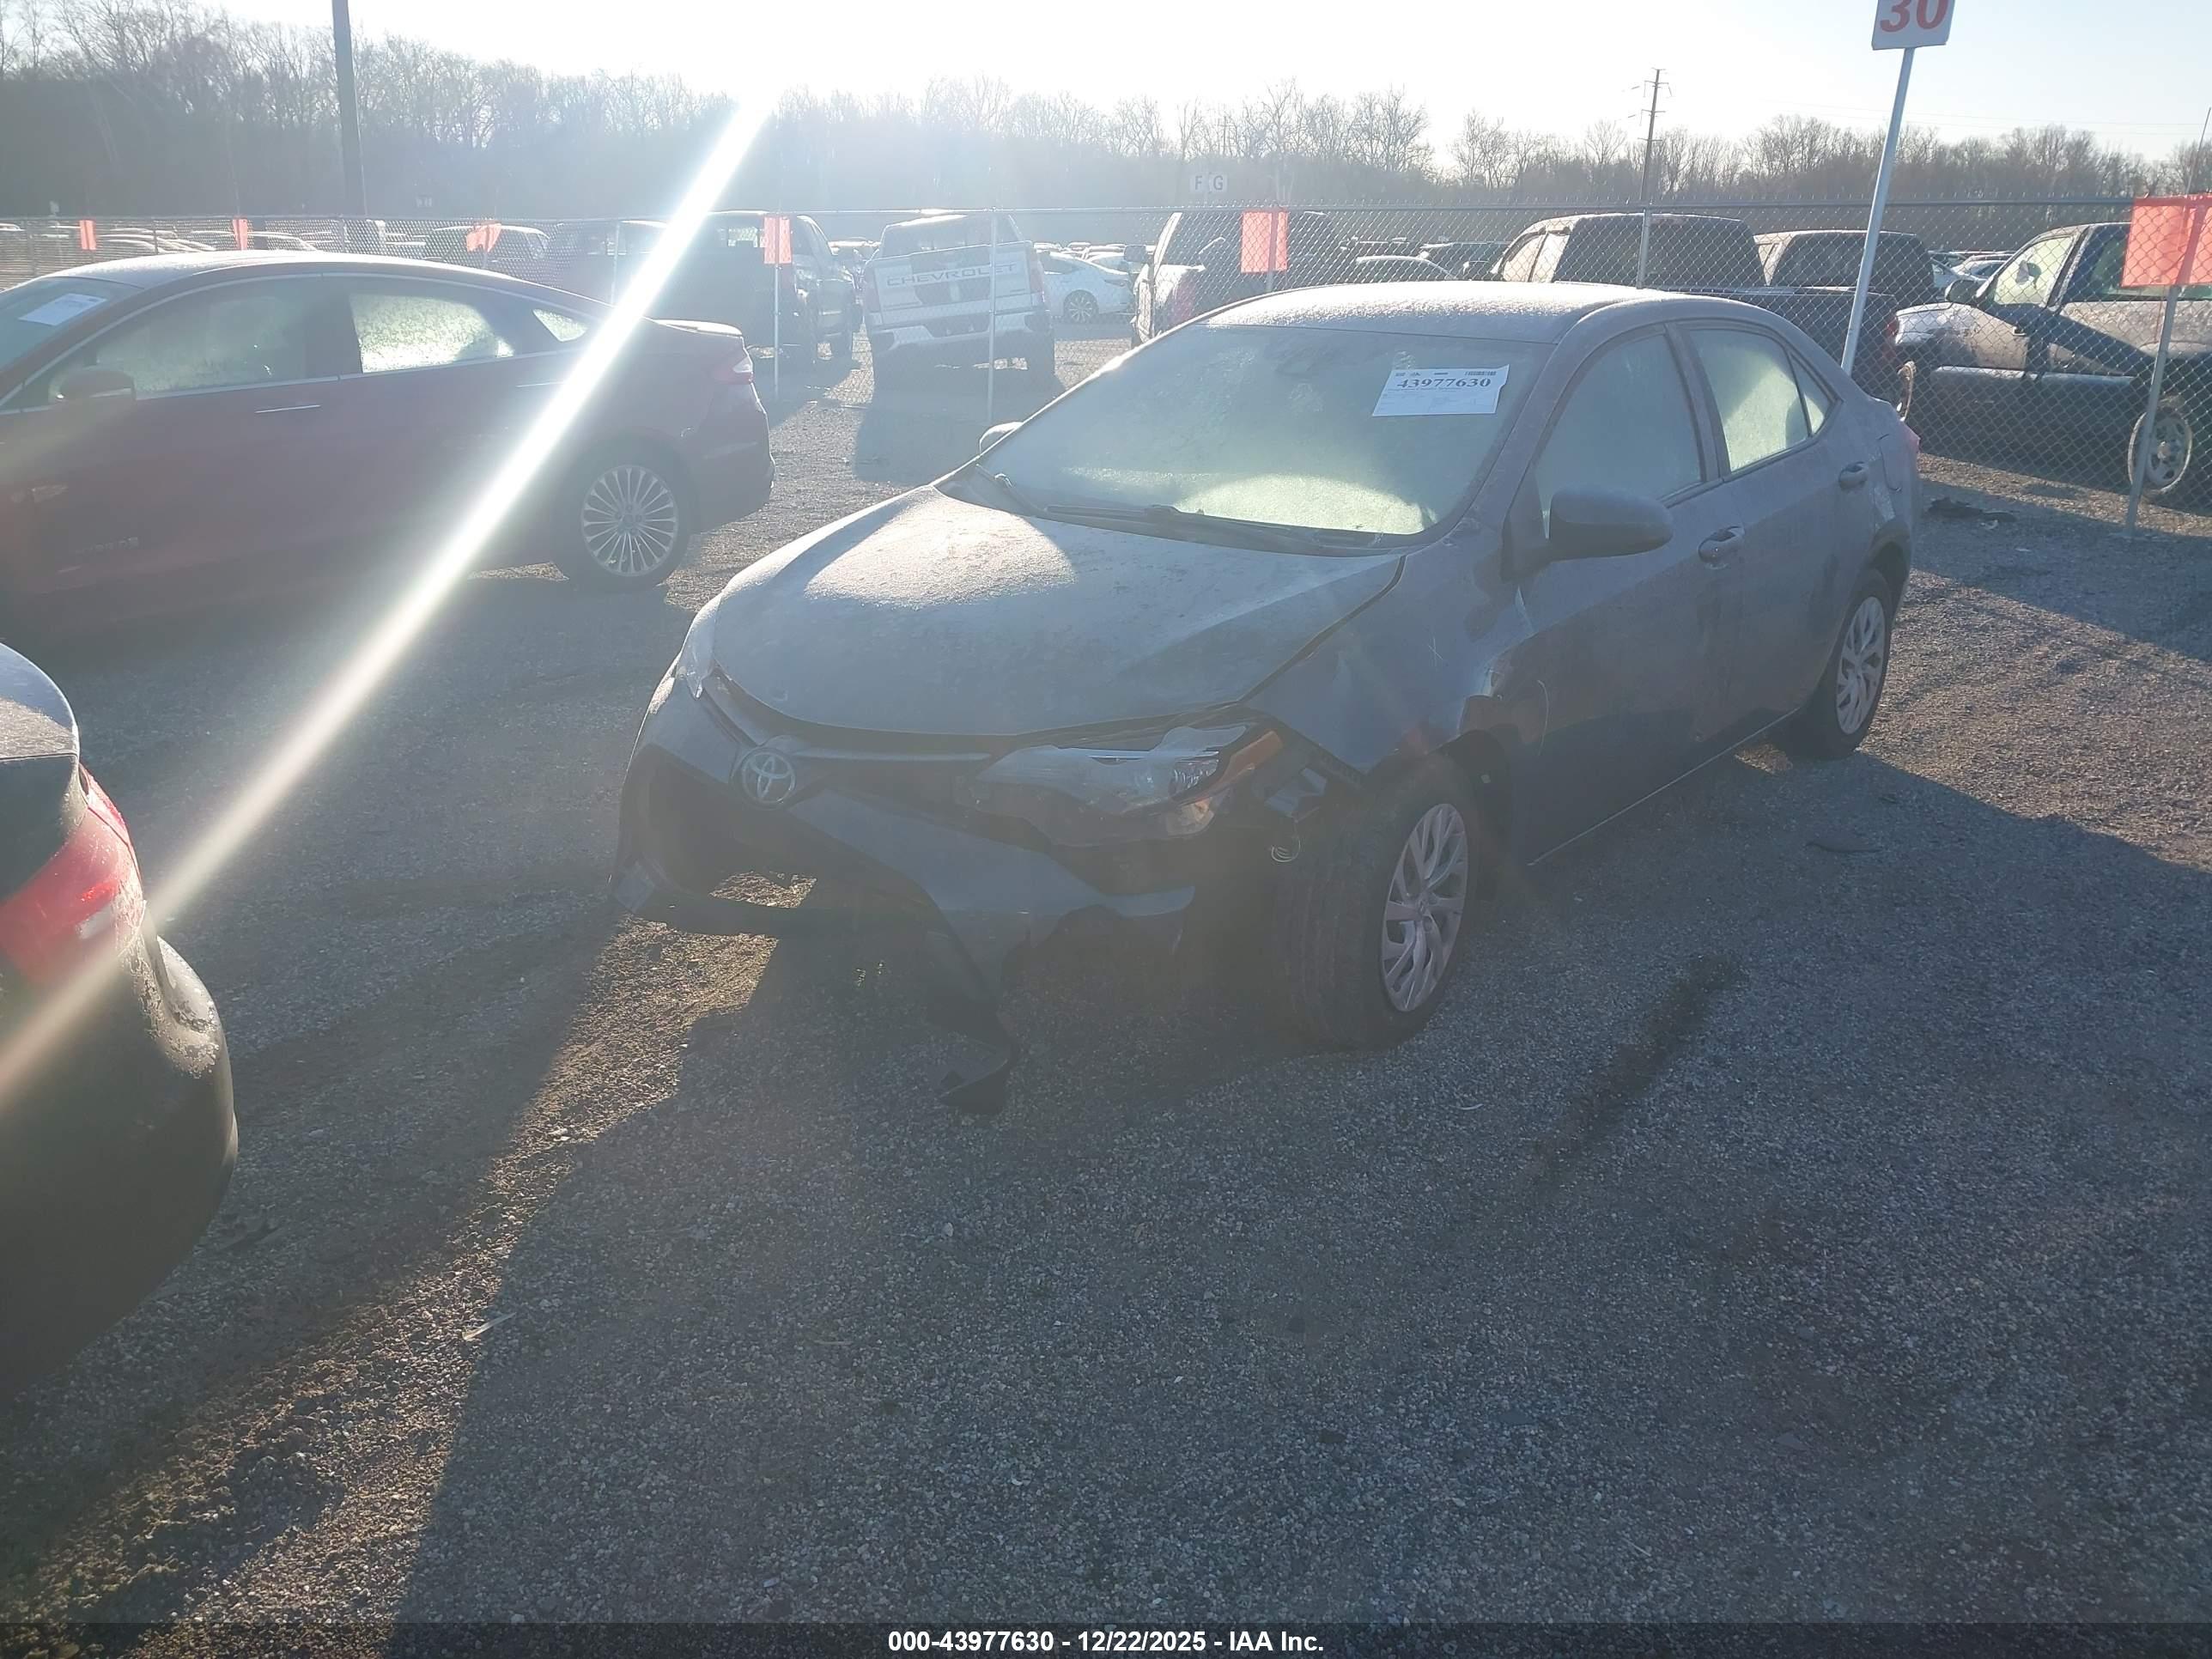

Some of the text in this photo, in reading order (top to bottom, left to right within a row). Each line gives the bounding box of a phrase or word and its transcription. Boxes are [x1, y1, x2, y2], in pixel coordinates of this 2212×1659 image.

[1880, 0, 1949, 33] 30
[1194, 175, 1224, 190] F G
[886, 262, 1017, 287] CHEVROLET
[1396, 378, 1492, 388] 43977630
